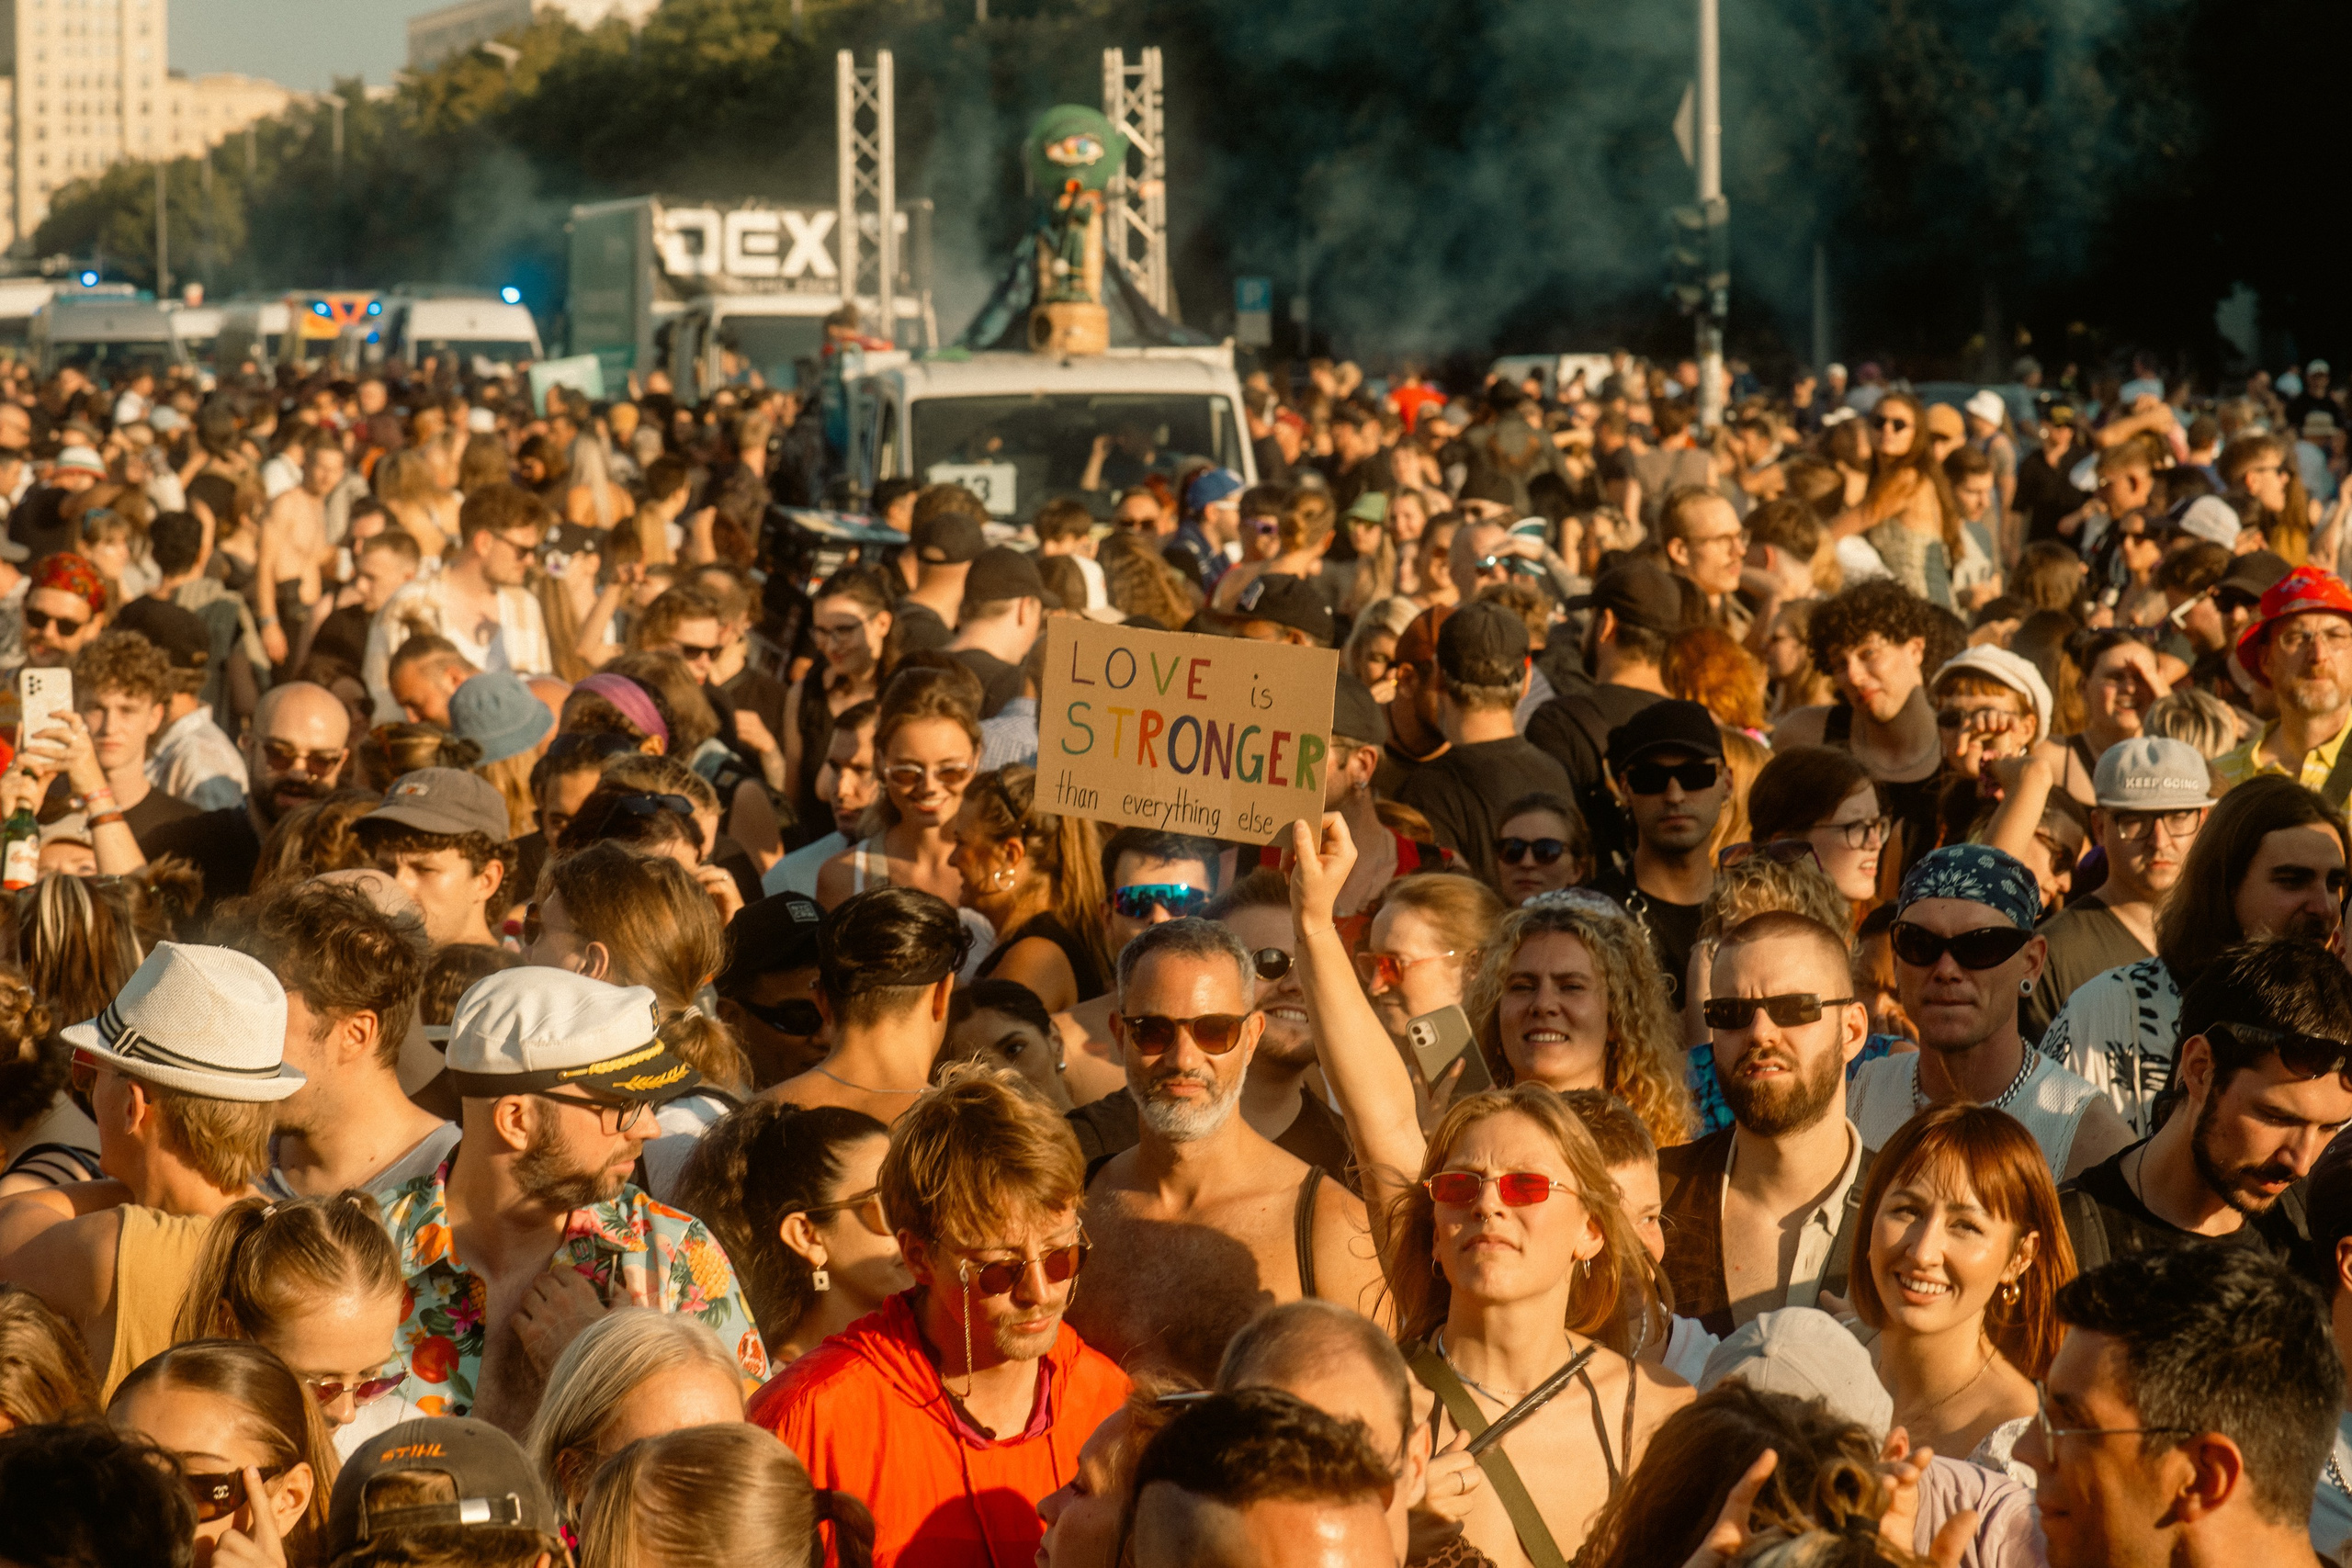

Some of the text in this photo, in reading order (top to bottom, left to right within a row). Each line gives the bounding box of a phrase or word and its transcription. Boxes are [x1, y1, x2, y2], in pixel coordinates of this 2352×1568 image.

[1071, 640, 1273, 710] LOVE is
[1061, 701, 1327, 792] STRONGER
[1056, 769, 1273, 836] than everything else
[2125, 777, 2199, 791] KEEP GOING
[379, 1443, 447, 1464] STIHL
